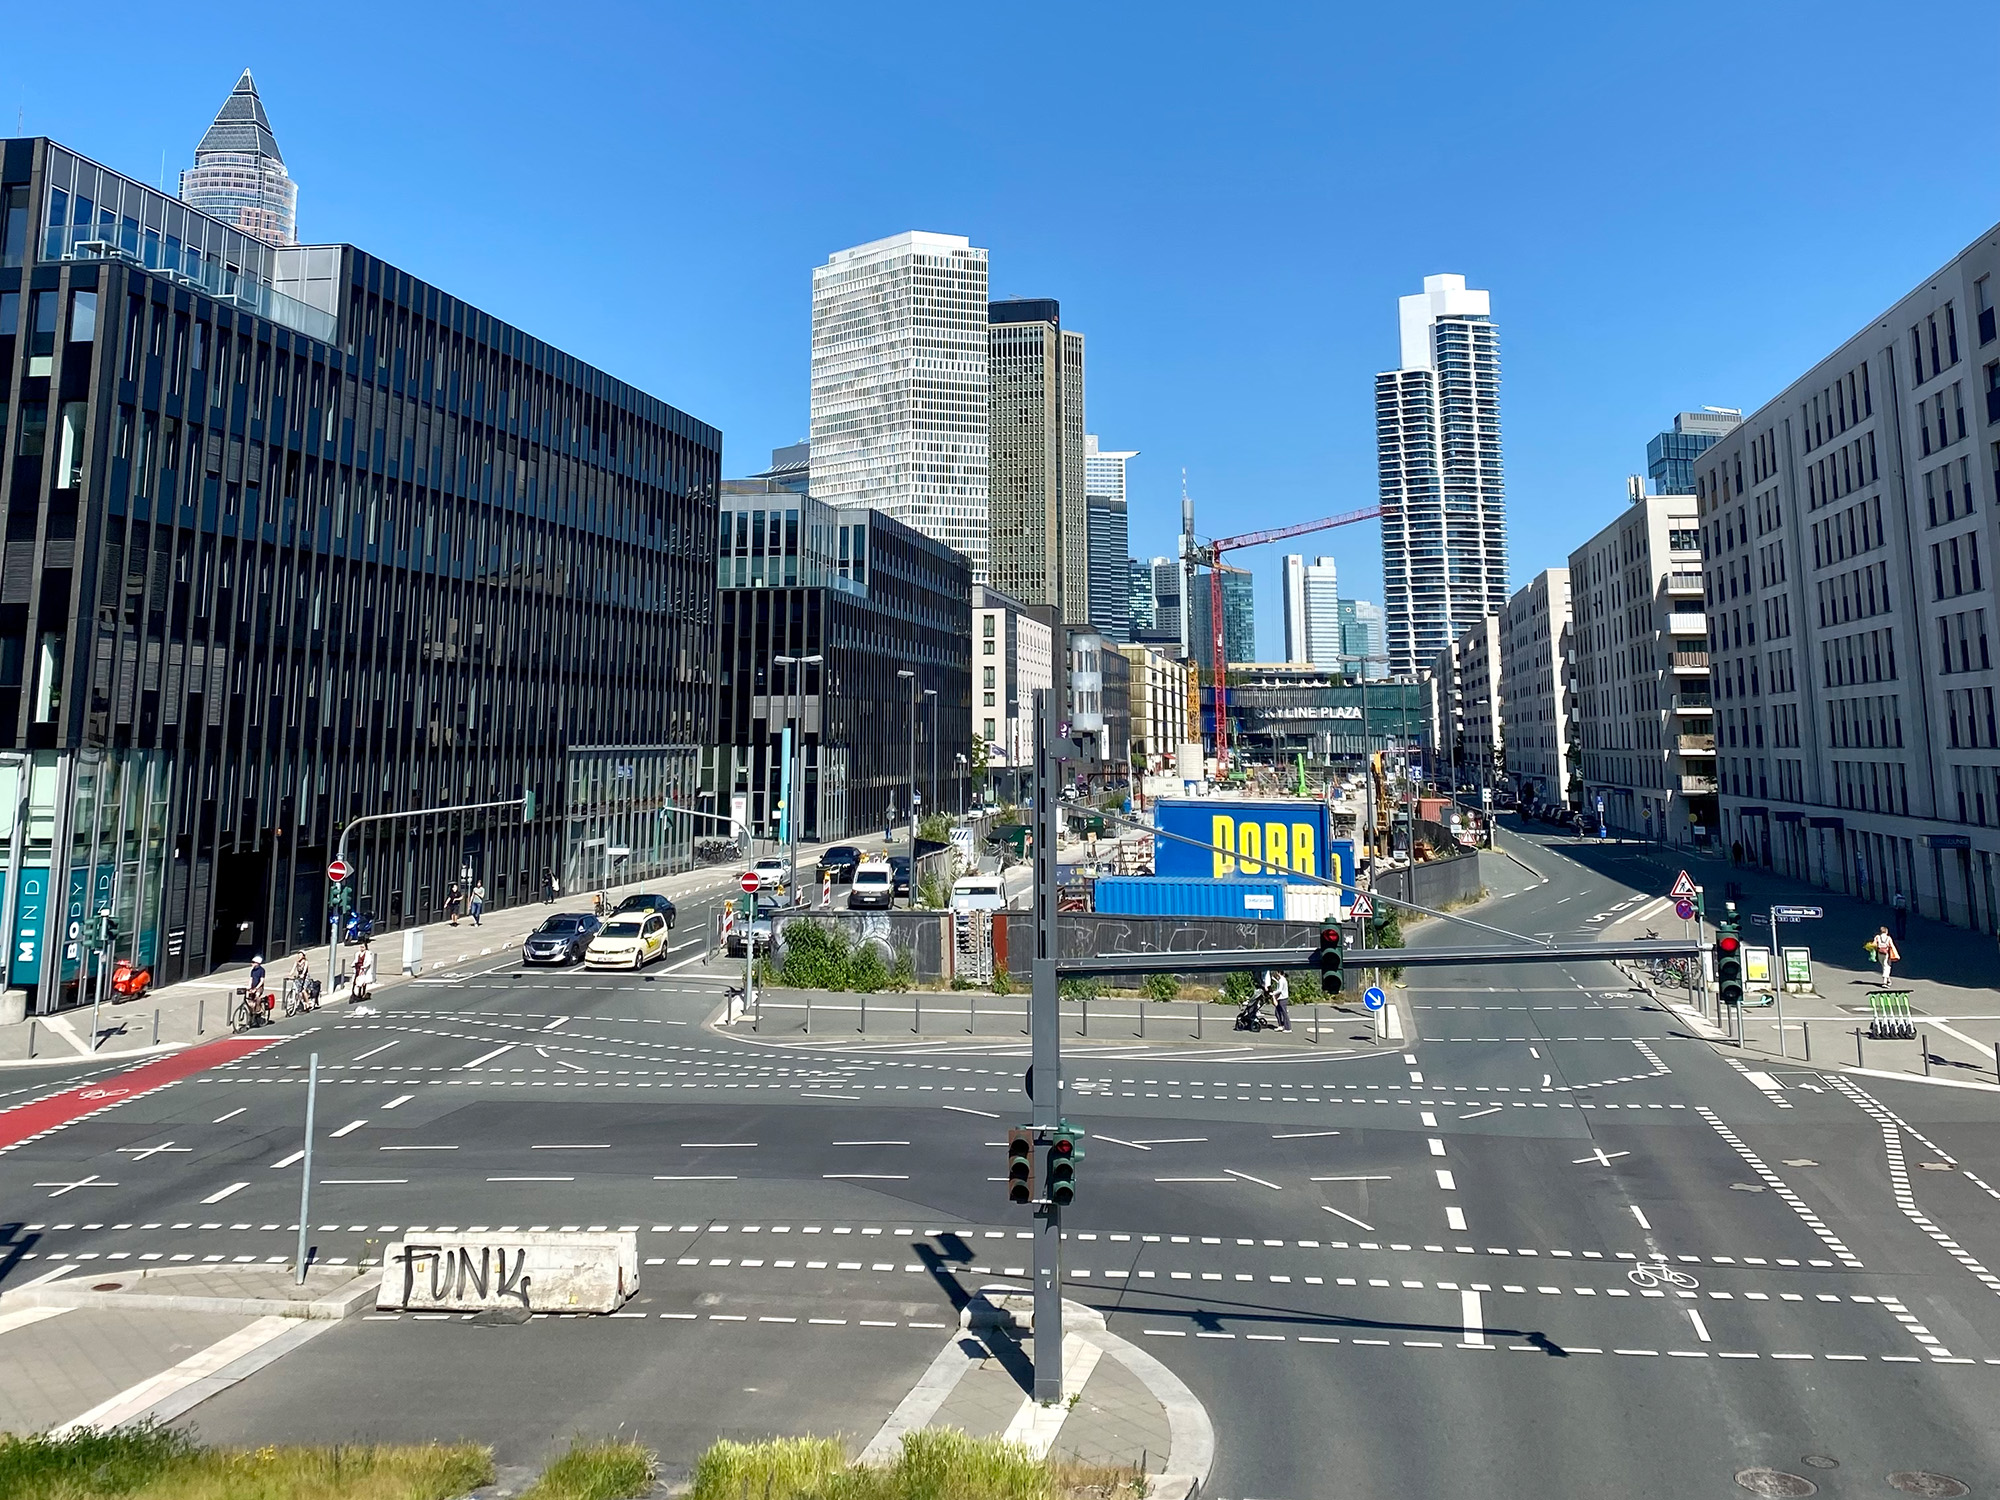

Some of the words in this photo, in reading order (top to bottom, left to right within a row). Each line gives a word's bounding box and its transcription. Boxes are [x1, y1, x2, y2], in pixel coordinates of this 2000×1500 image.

[1256, 706, 1317, 718] SKYLINE
[1320, 706, 1363, 718] PLAZA
[1213, 815, 1316, 878] PORR
[18, 880, 40, 962] MIND
[67, 882, 83, 959] BODY
[393, 1245, 532, 1309] FUNK
